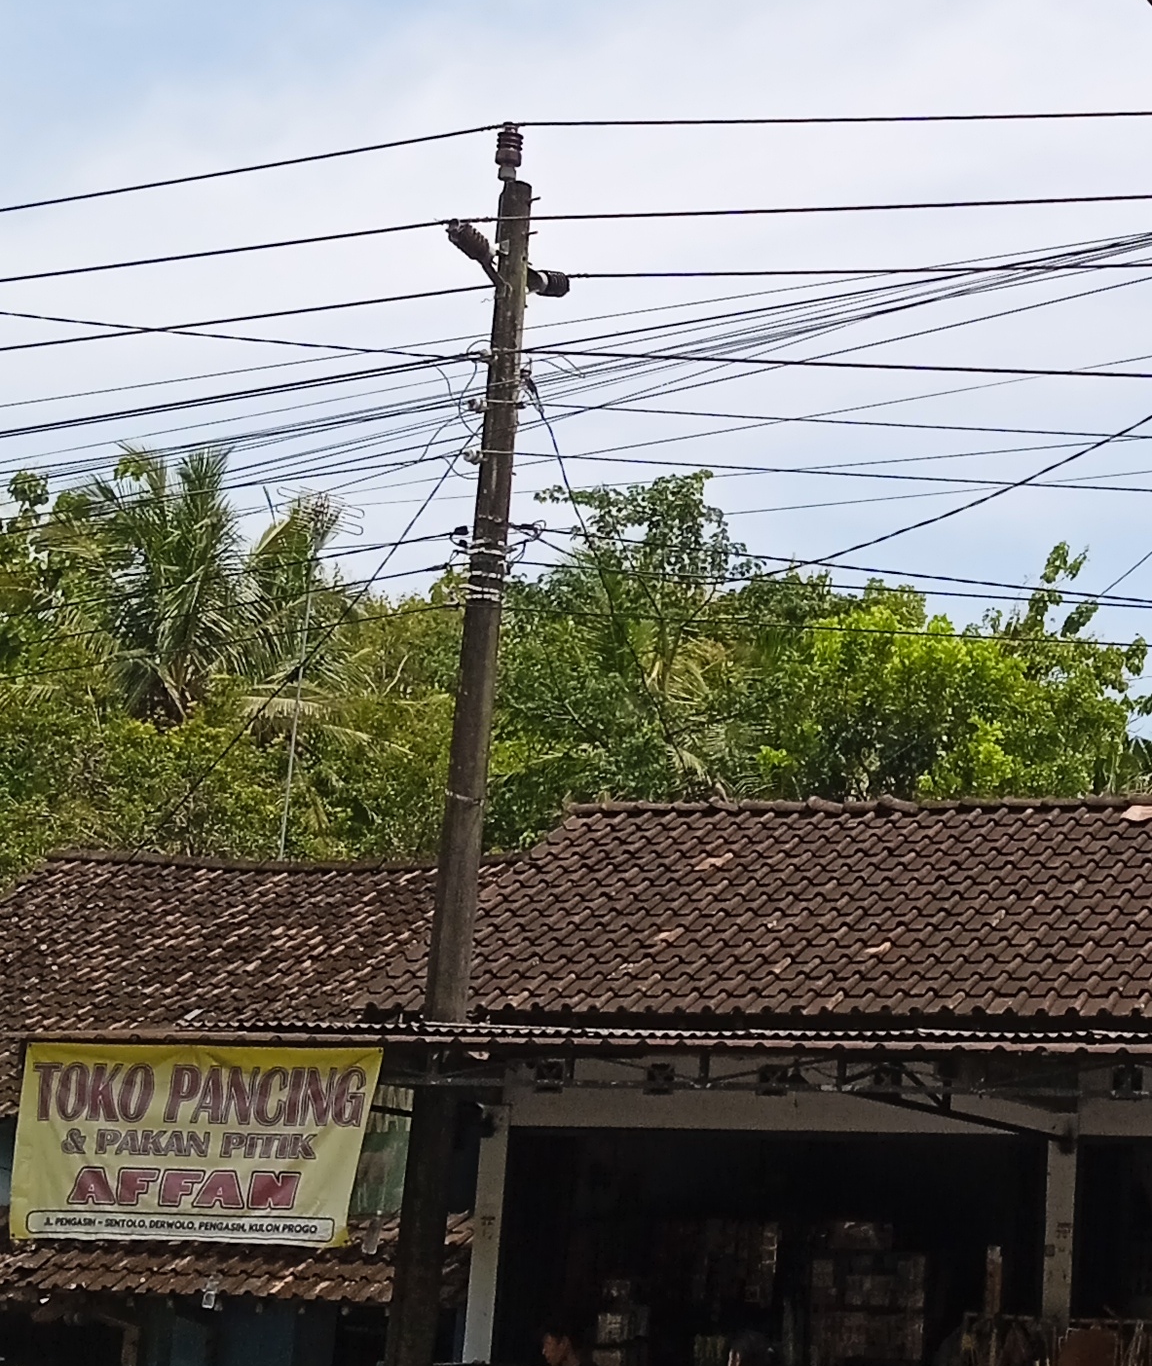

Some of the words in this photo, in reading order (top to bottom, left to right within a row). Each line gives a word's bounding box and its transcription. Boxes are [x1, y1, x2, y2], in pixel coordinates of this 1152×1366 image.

[34, 1062, 154, 1123] TOKO
[163, 1063, 367, 1128] PANCING
[61, 1128, 87, 1154] &
[96, 1129, 210, 1158] PAKAN
[221, 1131, 318, 1160] PITIK
[67, 1166, 302, 1210] AFFAN
[55, 1217, 96, 1227] PENGASIN
[248, 1222, 280, 1233] KULON
[282, 1224, 318, 1234] PROGO
